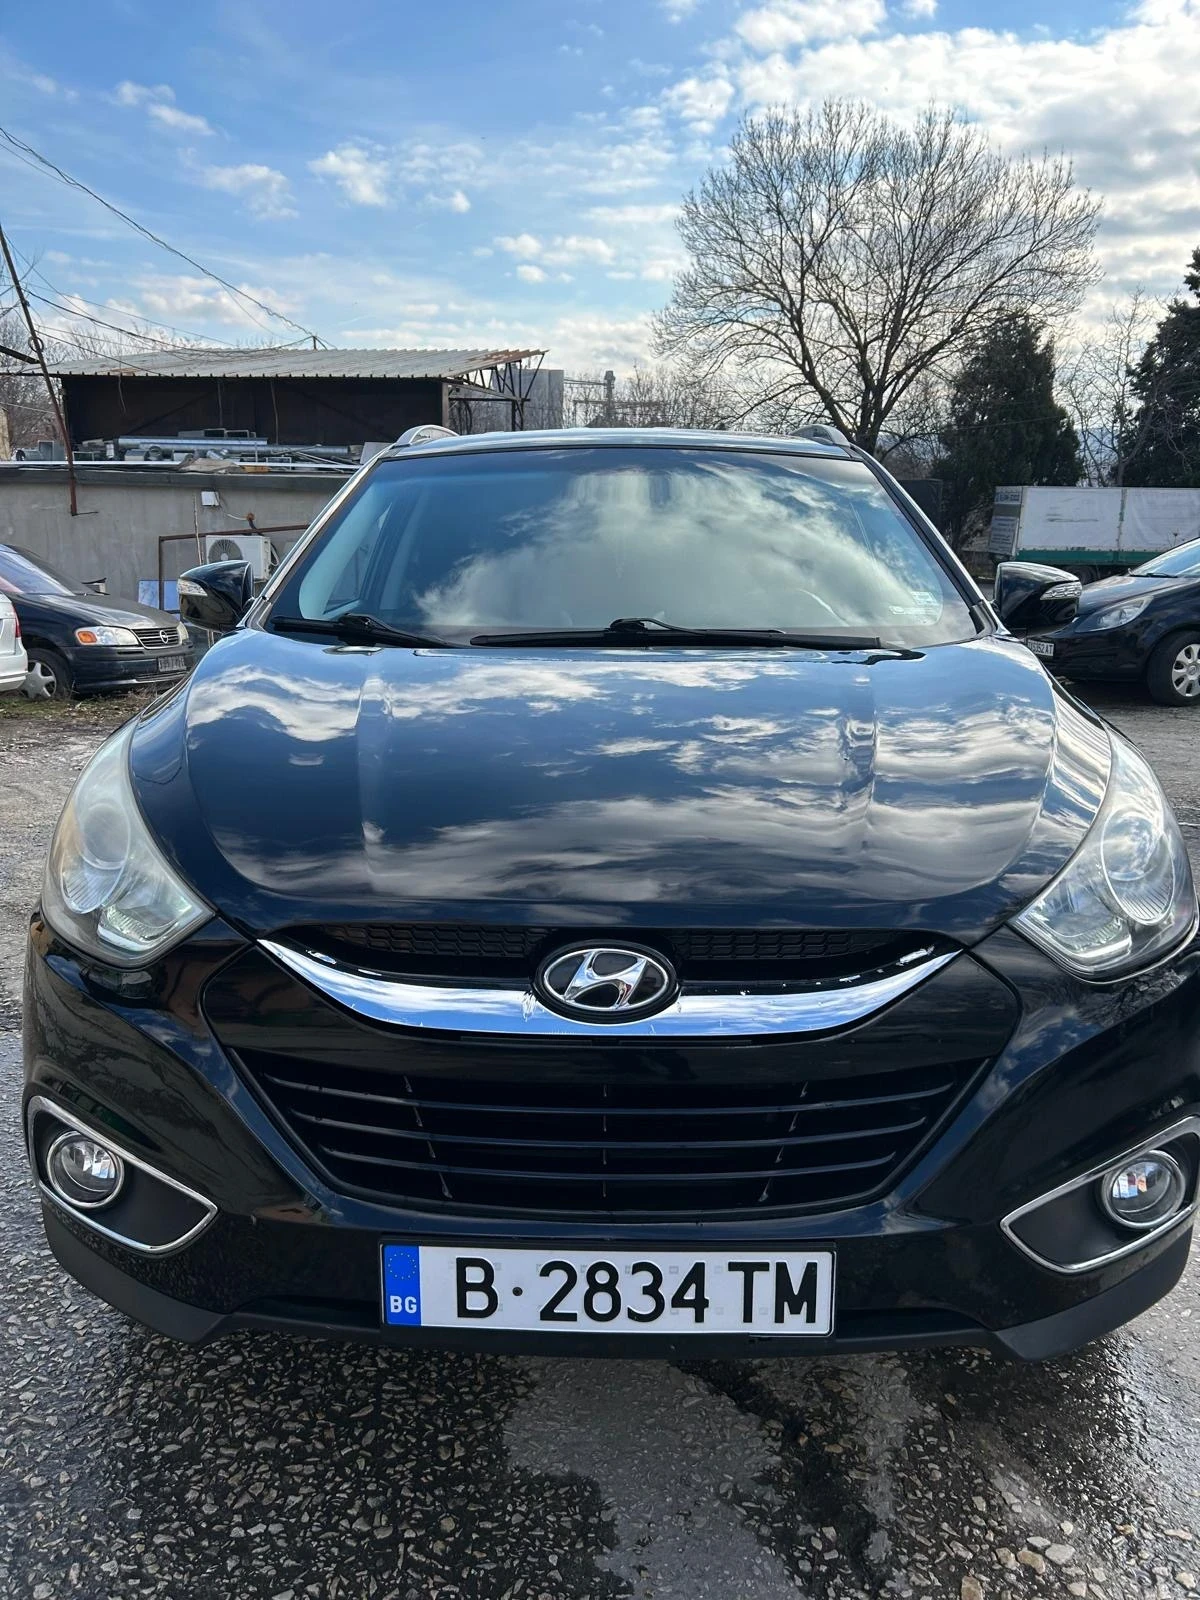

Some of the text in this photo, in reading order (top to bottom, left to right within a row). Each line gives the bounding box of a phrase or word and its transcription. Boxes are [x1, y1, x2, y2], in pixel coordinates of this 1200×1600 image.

[390, 1295, 417, 1313] BG
[456, 1257, 818, 1323] B 2834 TM
